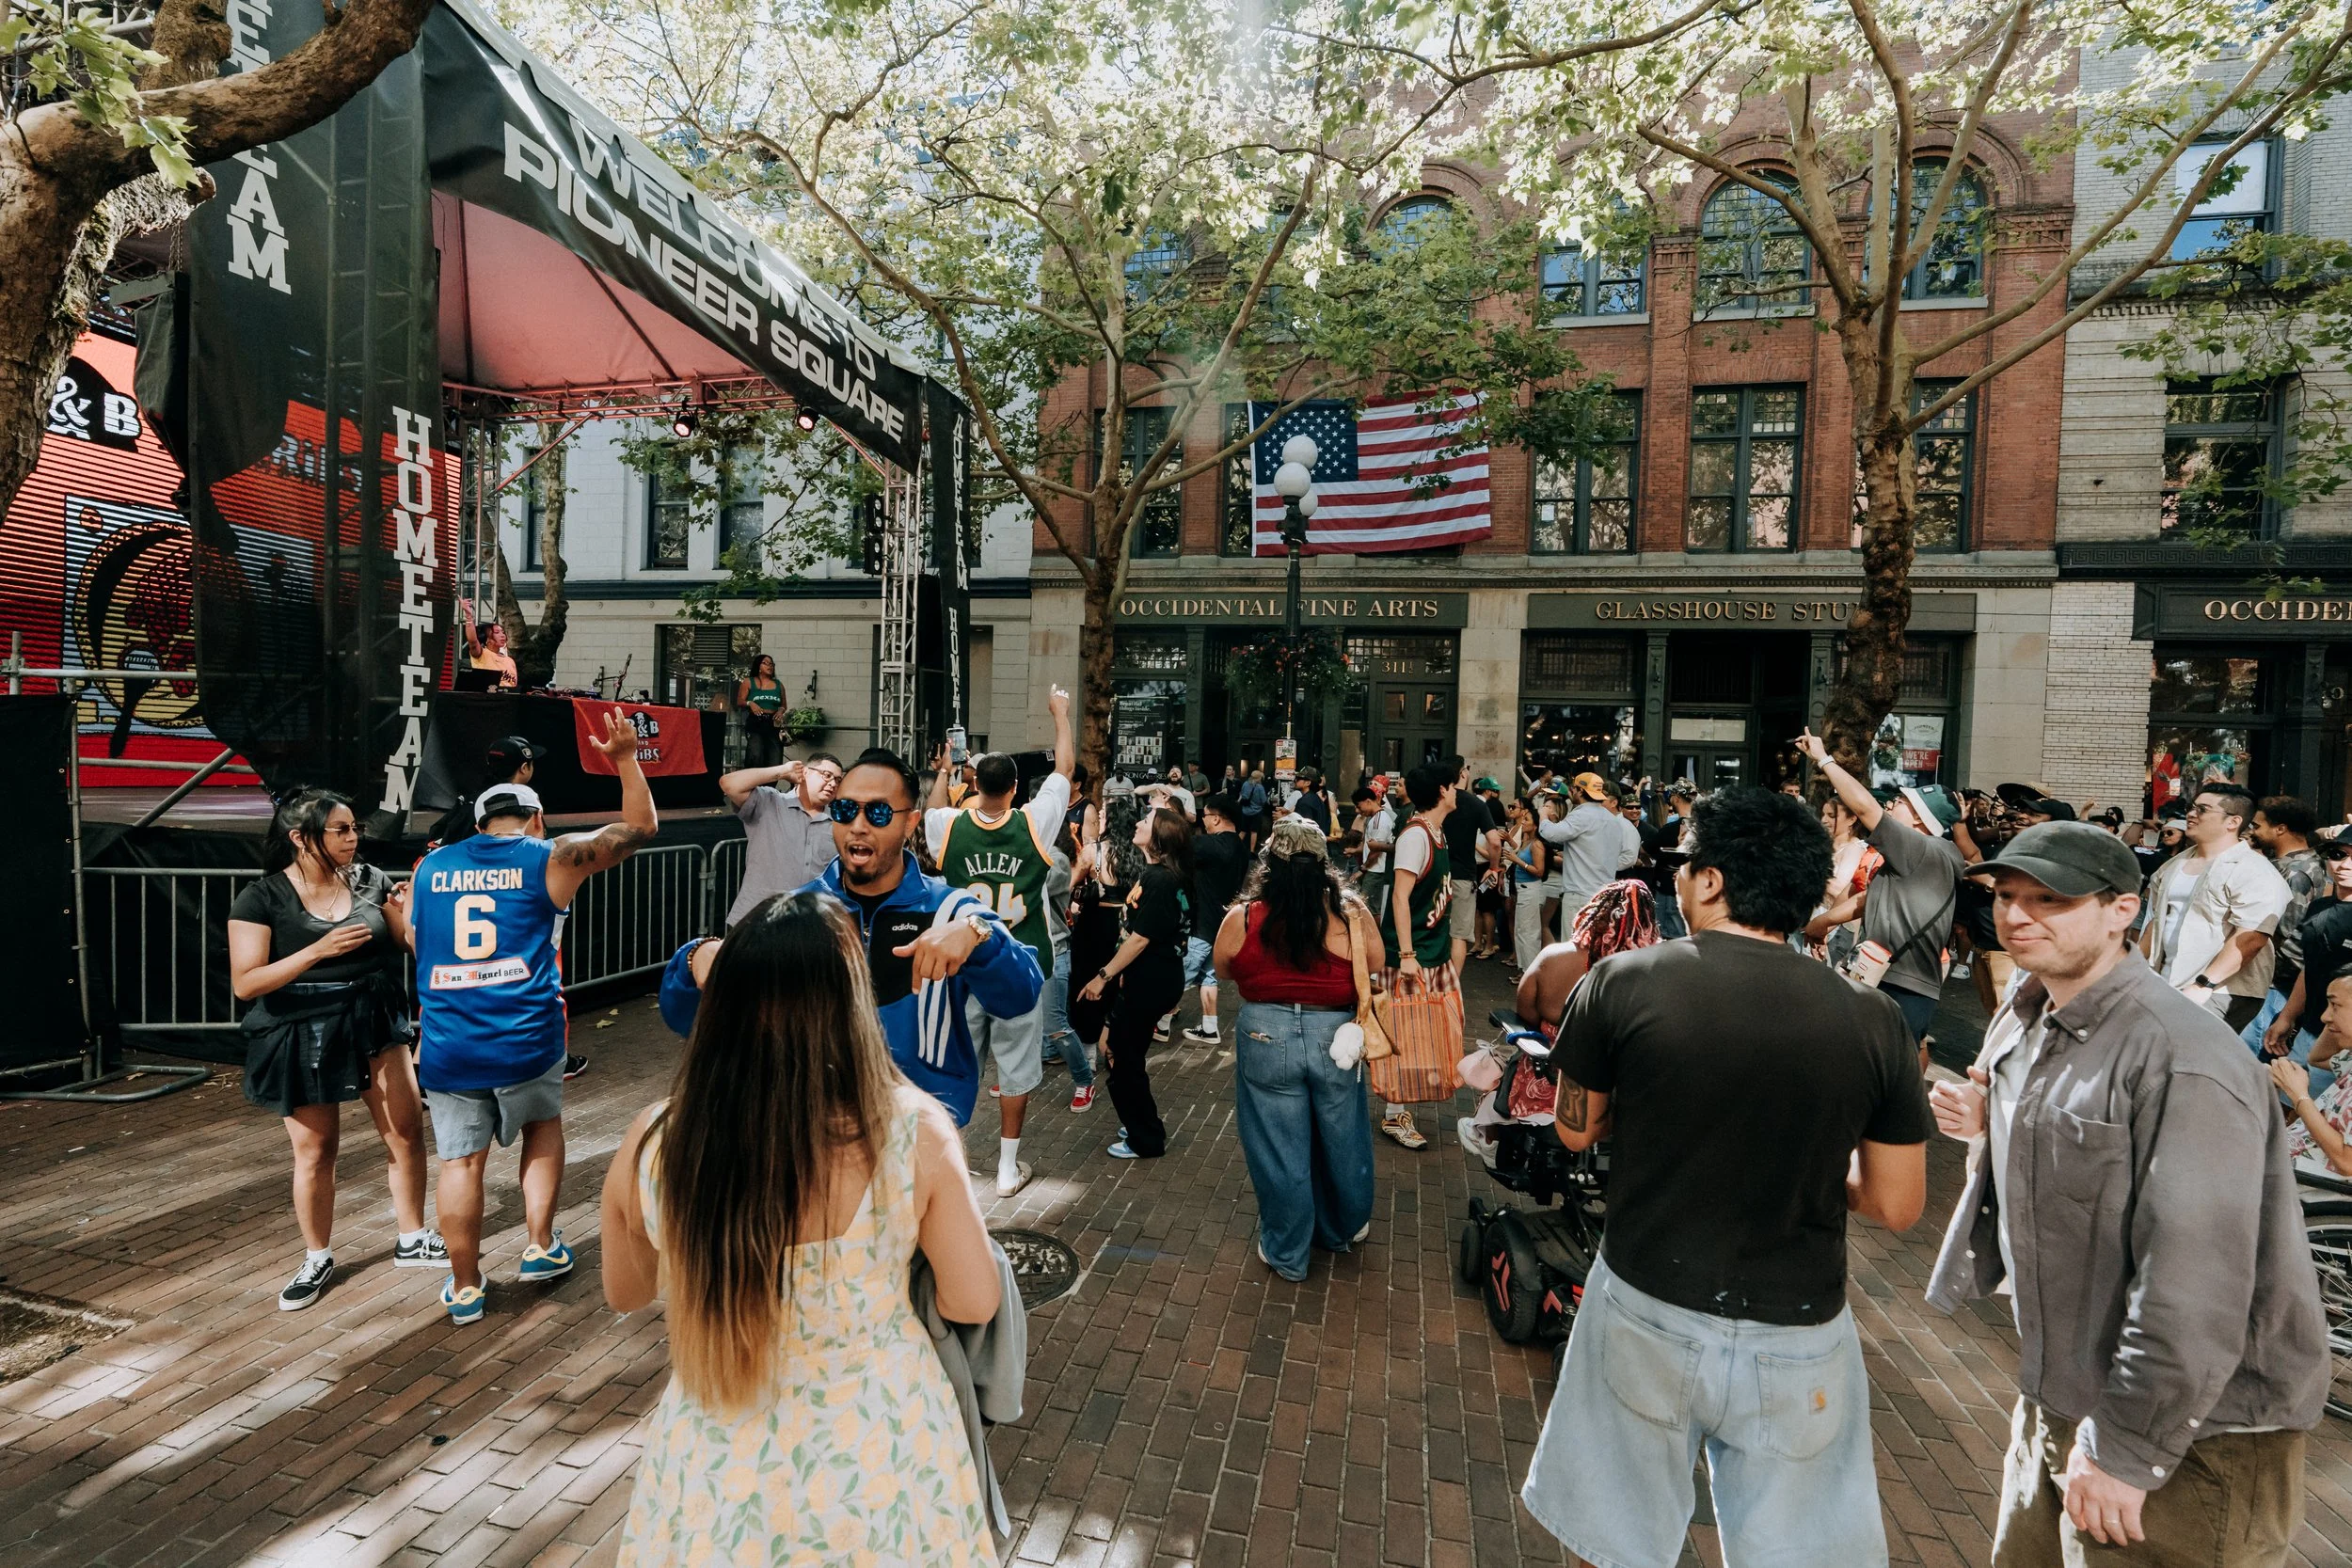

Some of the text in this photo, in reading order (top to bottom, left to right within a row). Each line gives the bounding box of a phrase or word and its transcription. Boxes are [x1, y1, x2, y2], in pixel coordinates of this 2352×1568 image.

[568, 114, 876, 381] WELCOME TO
[504, 121, 905, 445] PIONEER SQUARE
[952, 412, 968, 591] HOMETEAM
[1120, 599, 1282, 616] OCCIDENTAL
[1368, 599, 1438, 617] ARTS
[1596, 601, 1777, 620] GLASSHOUSE
[1905, 751, 1929, 760] WE'RE
[964, 852, 1024, 878] ALLEN
[432, 868, 523, 893] CLARKSON
[454, 895, 497, 960] 6
[892, 923, 918, 931] adidas
[443, 967, 524, 983] San Miguel BEER
